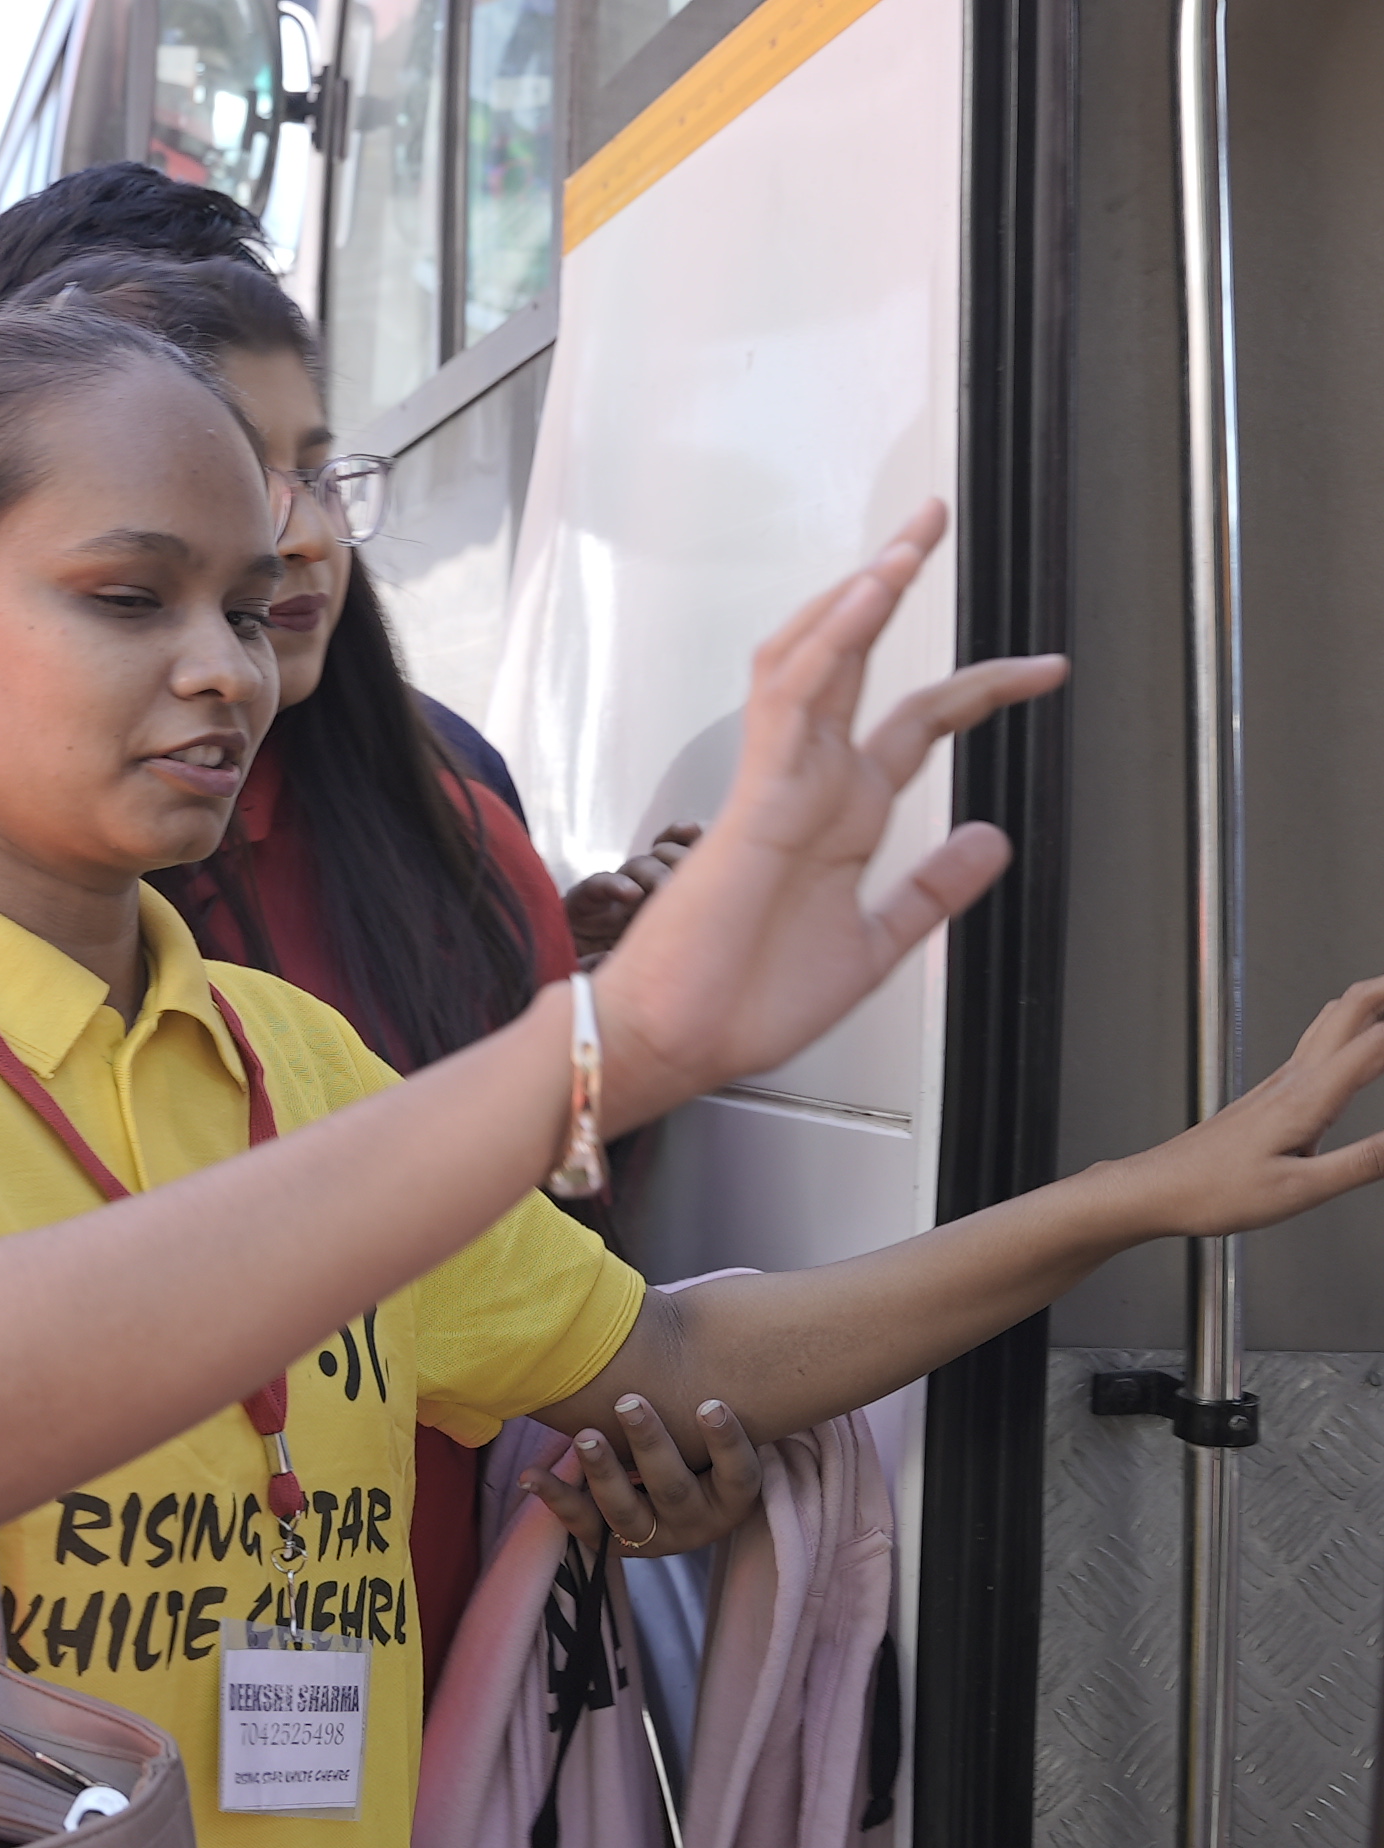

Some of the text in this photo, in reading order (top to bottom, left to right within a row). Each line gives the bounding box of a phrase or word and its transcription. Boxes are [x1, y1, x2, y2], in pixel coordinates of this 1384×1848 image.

[54, 1487, 392, 1568] RISING STAR
[2, 1585, 228, 1677] KHILTE
[297, 1684, 359, 1713] SHARMA
[240, 1721, 345, 1746] 7042525498
